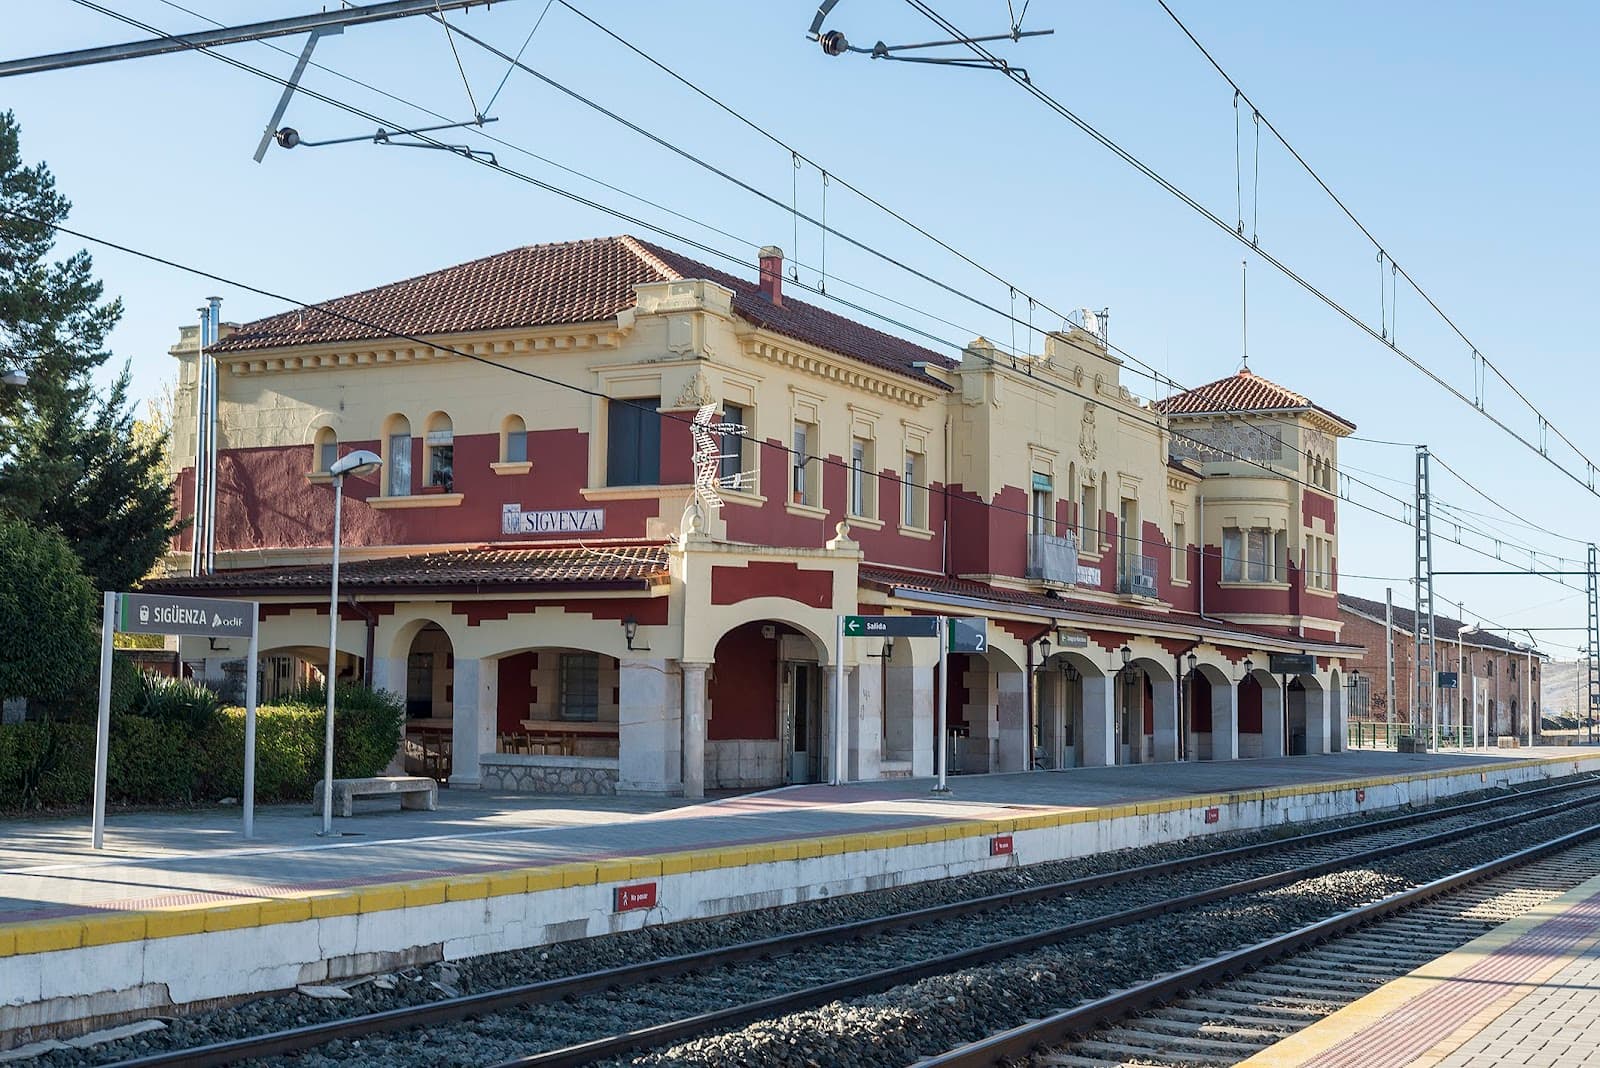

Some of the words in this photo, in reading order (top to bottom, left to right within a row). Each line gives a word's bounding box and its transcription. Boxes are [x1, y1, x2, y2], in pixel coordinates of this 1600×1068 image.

[525, 511, 599, 531] SIGVENZA
[154, 604, 207, 625] SIGÜENZA
[222, 617, 243, 627] adif
[866, 621, 887, 630] Salida
[975, 634, 984, 651] 2
[1451, 679, 1457, 688] 2
